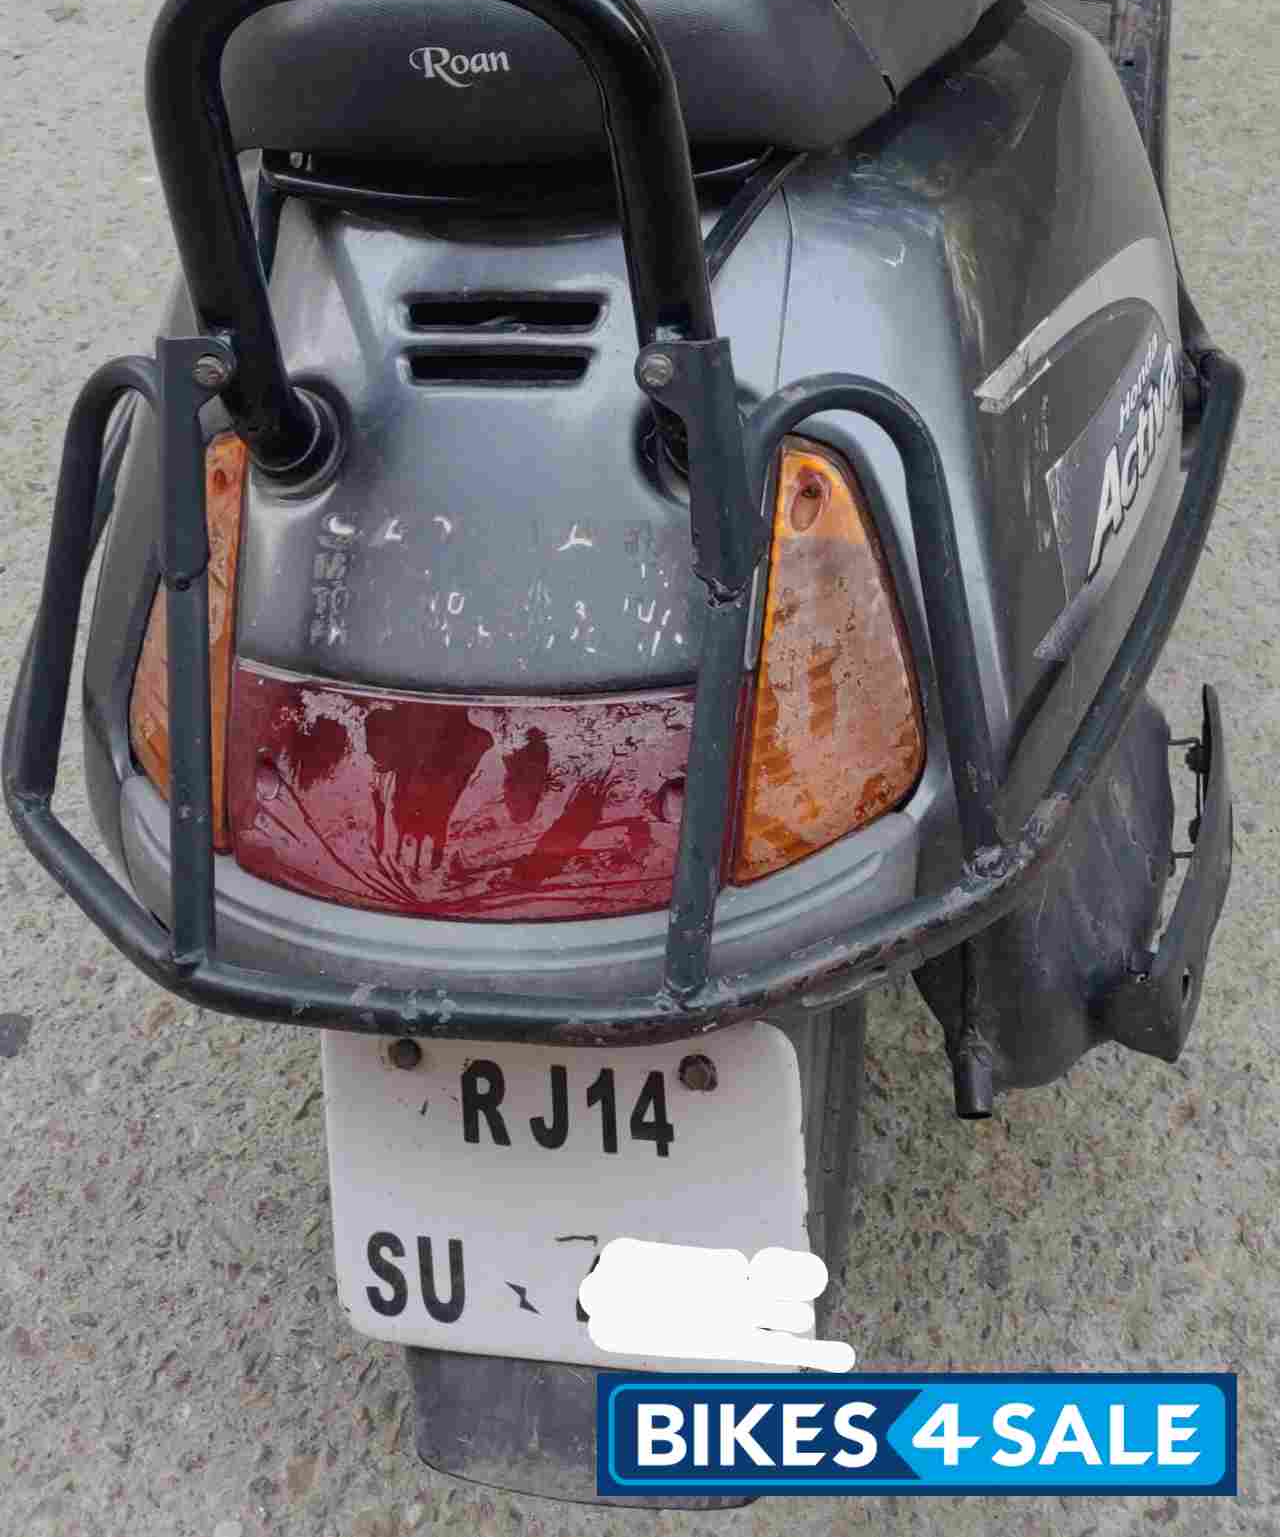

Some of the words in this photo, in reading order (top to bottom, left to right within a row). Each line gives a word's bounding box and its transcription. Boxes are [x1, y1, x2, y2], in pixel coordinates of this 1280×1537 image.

[408, 46, 511, 88] Roan
[1086, 341, 1178, 583] Activa
[366, 1231, 466, 1323] SU
